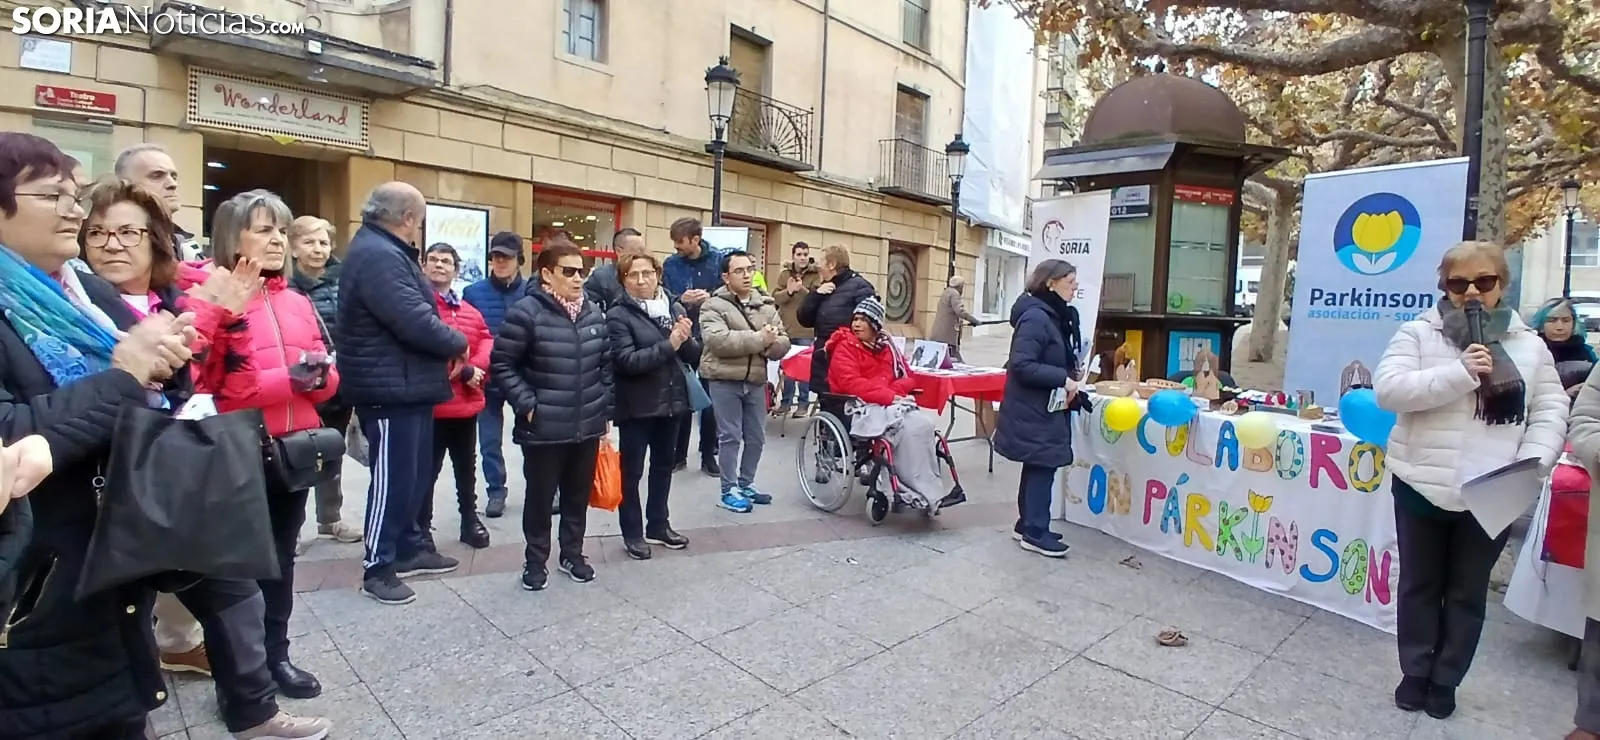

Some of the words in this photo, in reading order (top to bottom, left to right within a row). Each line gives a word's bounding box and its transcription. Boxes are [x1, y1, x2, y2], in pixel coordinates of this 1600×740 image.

[214, 83, 349, 127] Wonderland
[1060, 242, 1090, 255] SORIA
[1307, 308, 1380, 321] asociación
[1309, 287, 1434, 309] Parkinson
[1136, 412, 1387, 494] COLABORO
[1064, 460, 1132, 516] CON
